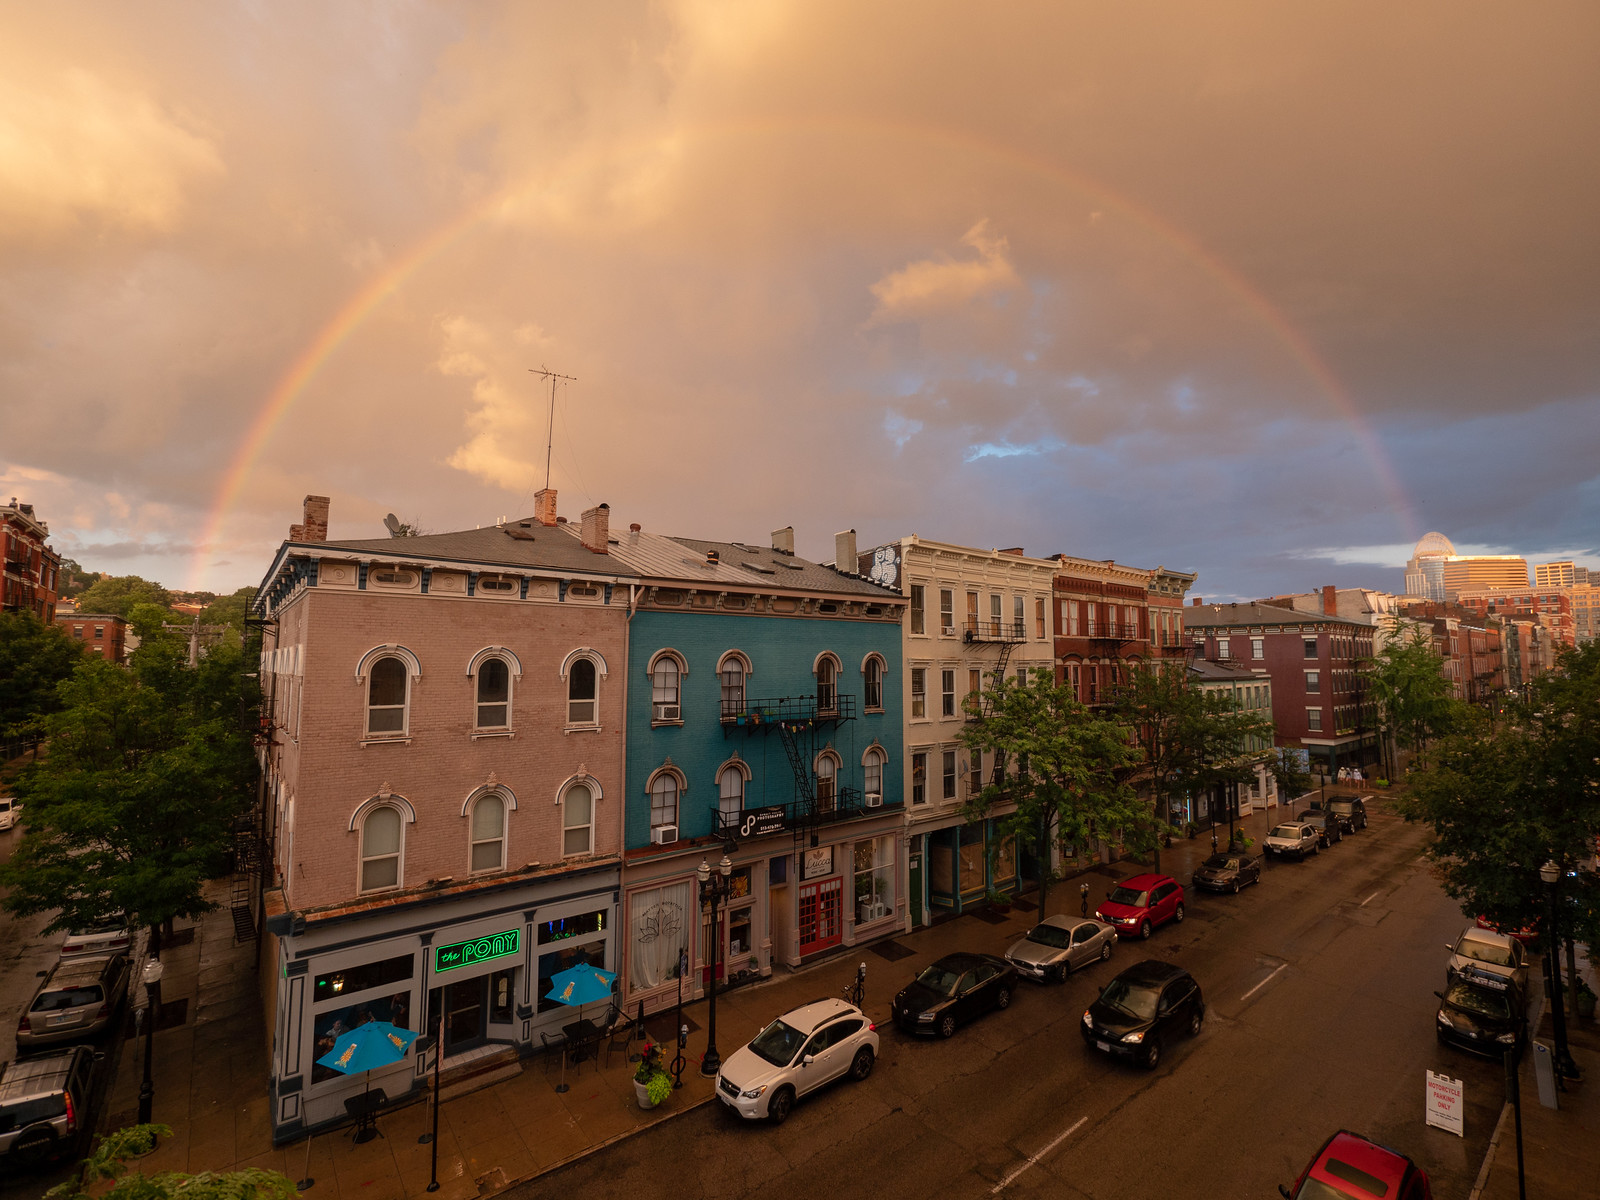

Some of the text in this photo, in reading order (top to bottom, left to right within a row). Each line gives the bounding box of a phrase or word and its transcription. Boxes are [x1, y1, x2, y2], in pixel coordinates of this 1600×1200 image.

[757, 813, 784, 821] PHOTOGRAPHY
[806, 858, 831, 869] Lucca
[441, 933, 516, 963] the PONY
[1428, 1081, 1460, 1096] MOTORCYCLE
[1433, 1092, 1455, 1104] PARKING
[1438, 1102, 1451, 1111] ONLY
